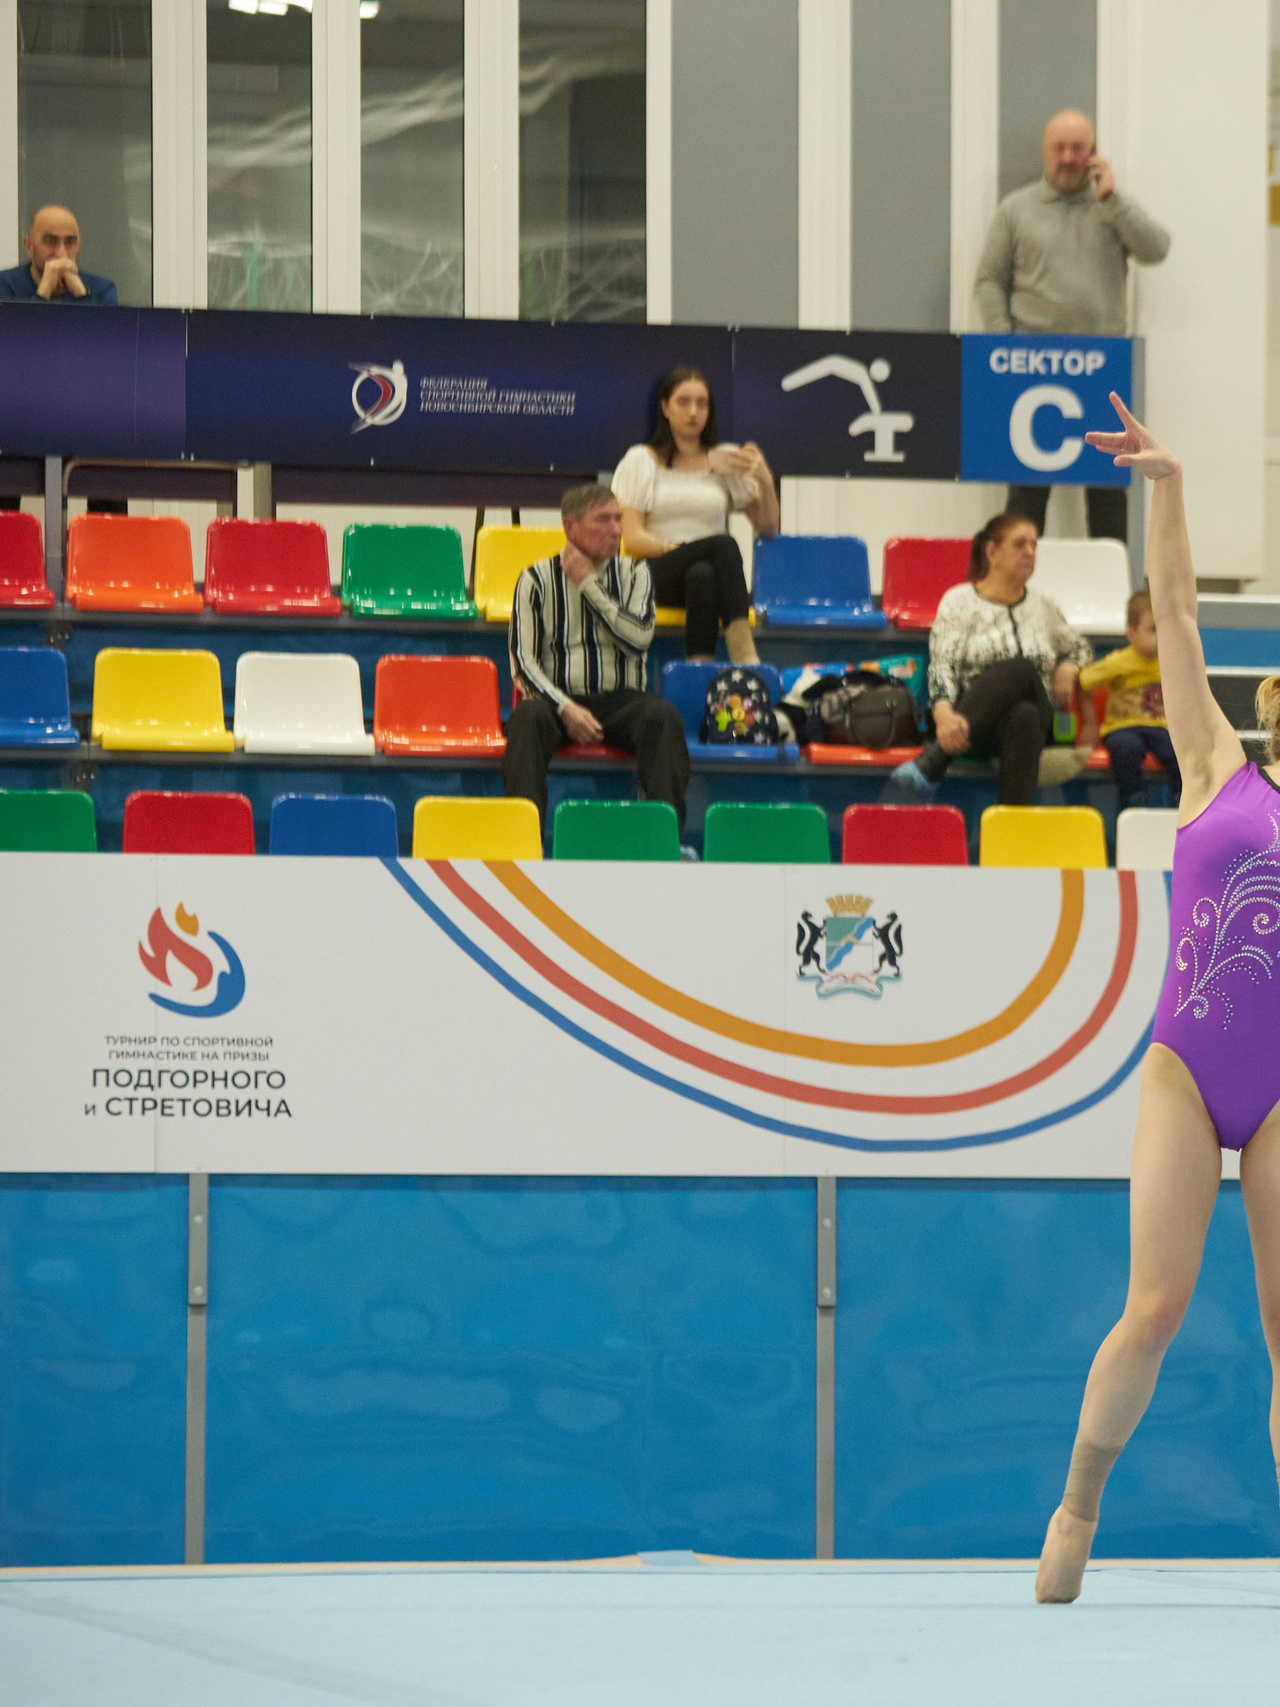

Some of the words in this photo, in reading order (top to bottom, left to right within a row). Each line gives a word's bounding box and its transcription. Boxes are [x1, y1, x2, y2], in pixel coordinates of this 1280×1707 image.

[989, 347, 1106, 376] СЕКТОР
[105, 1035, 157, 1046] ТУРНИР
[160, 1036, 180, 1047] ПО
[183, 1034, 273, 1048] СПОРТИВНОЙ
[108, 1050, 198, 1062] ГИМНАСТИКЕ
[201, 1051, 219, 1061] НА
[223, 1051, 269, 1062] ПРИЗЫ
[92, 1068, 286, 1091] ПОДГОРНОГО
[84, 1104, 96, 1116] и
[105, 1096, 292, 1119] СТРЕТОВИЧА
